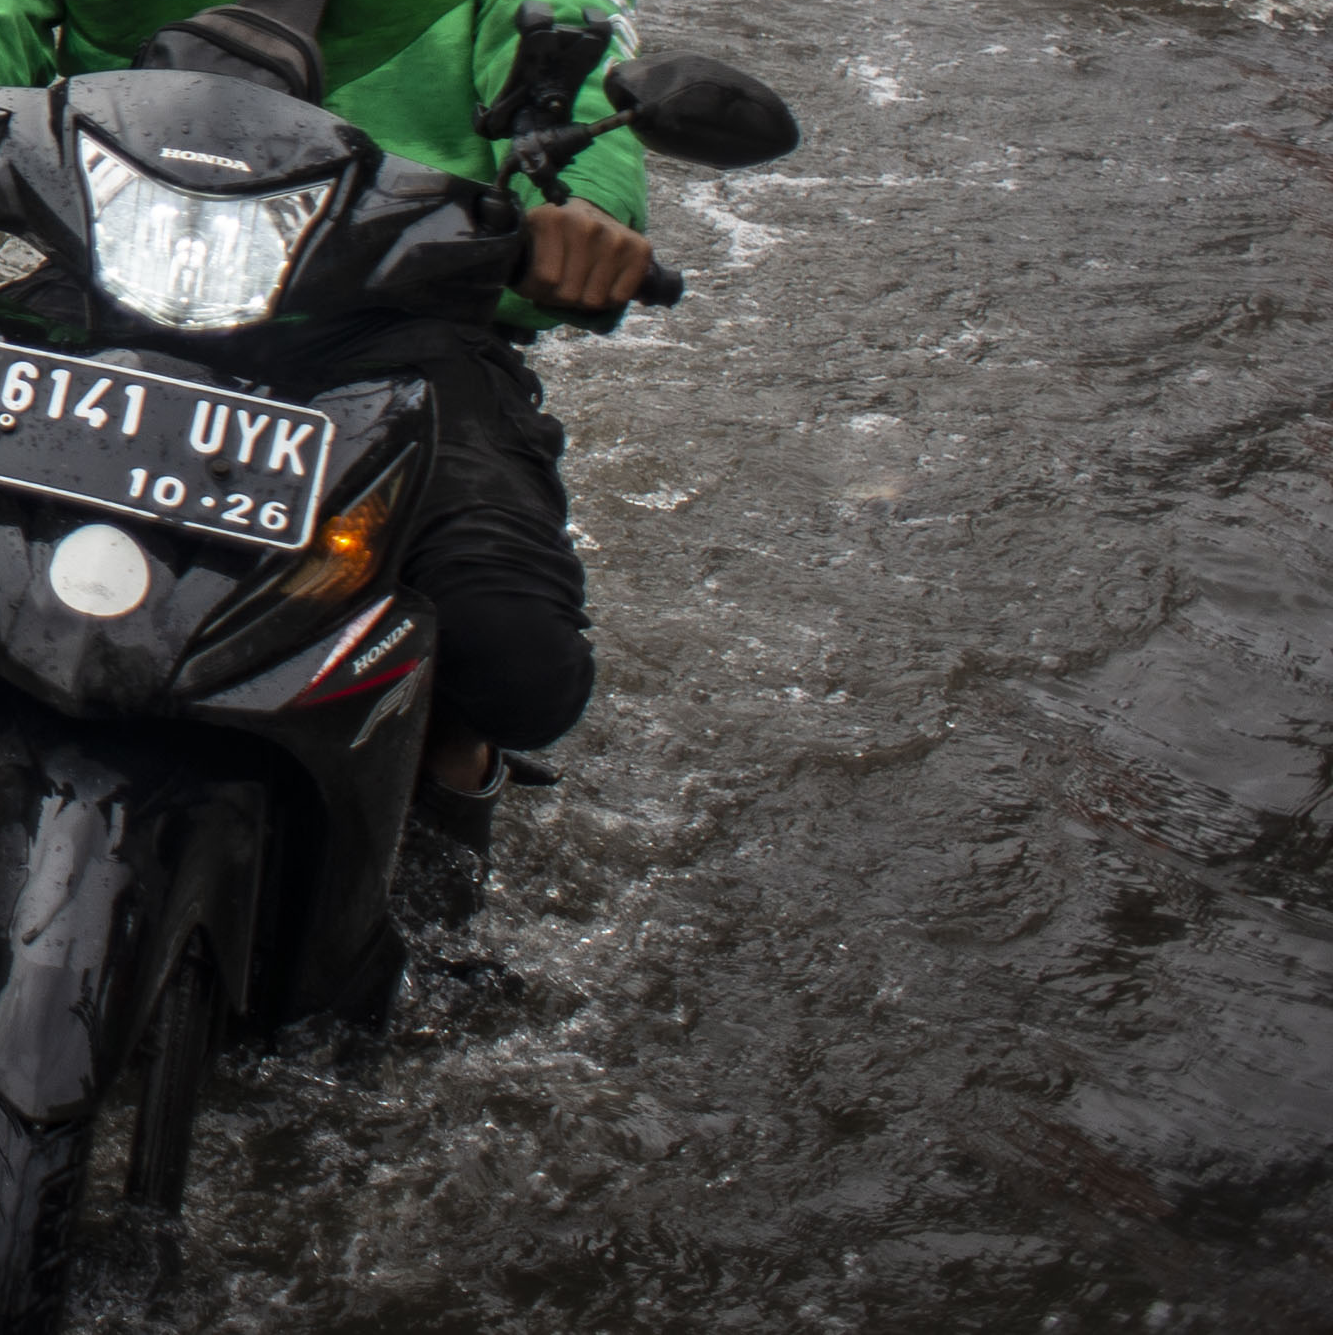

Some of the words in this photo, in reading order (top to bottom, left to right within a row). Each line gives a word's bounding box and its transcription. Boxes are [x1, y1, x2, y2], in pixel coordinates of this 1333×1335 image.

[159, 147, 252, 172] HONDA
[1, 361, 146, 436] 6141
[189, 400, 314, 476] UYK
[353, 618, 414, 675] HONDA
